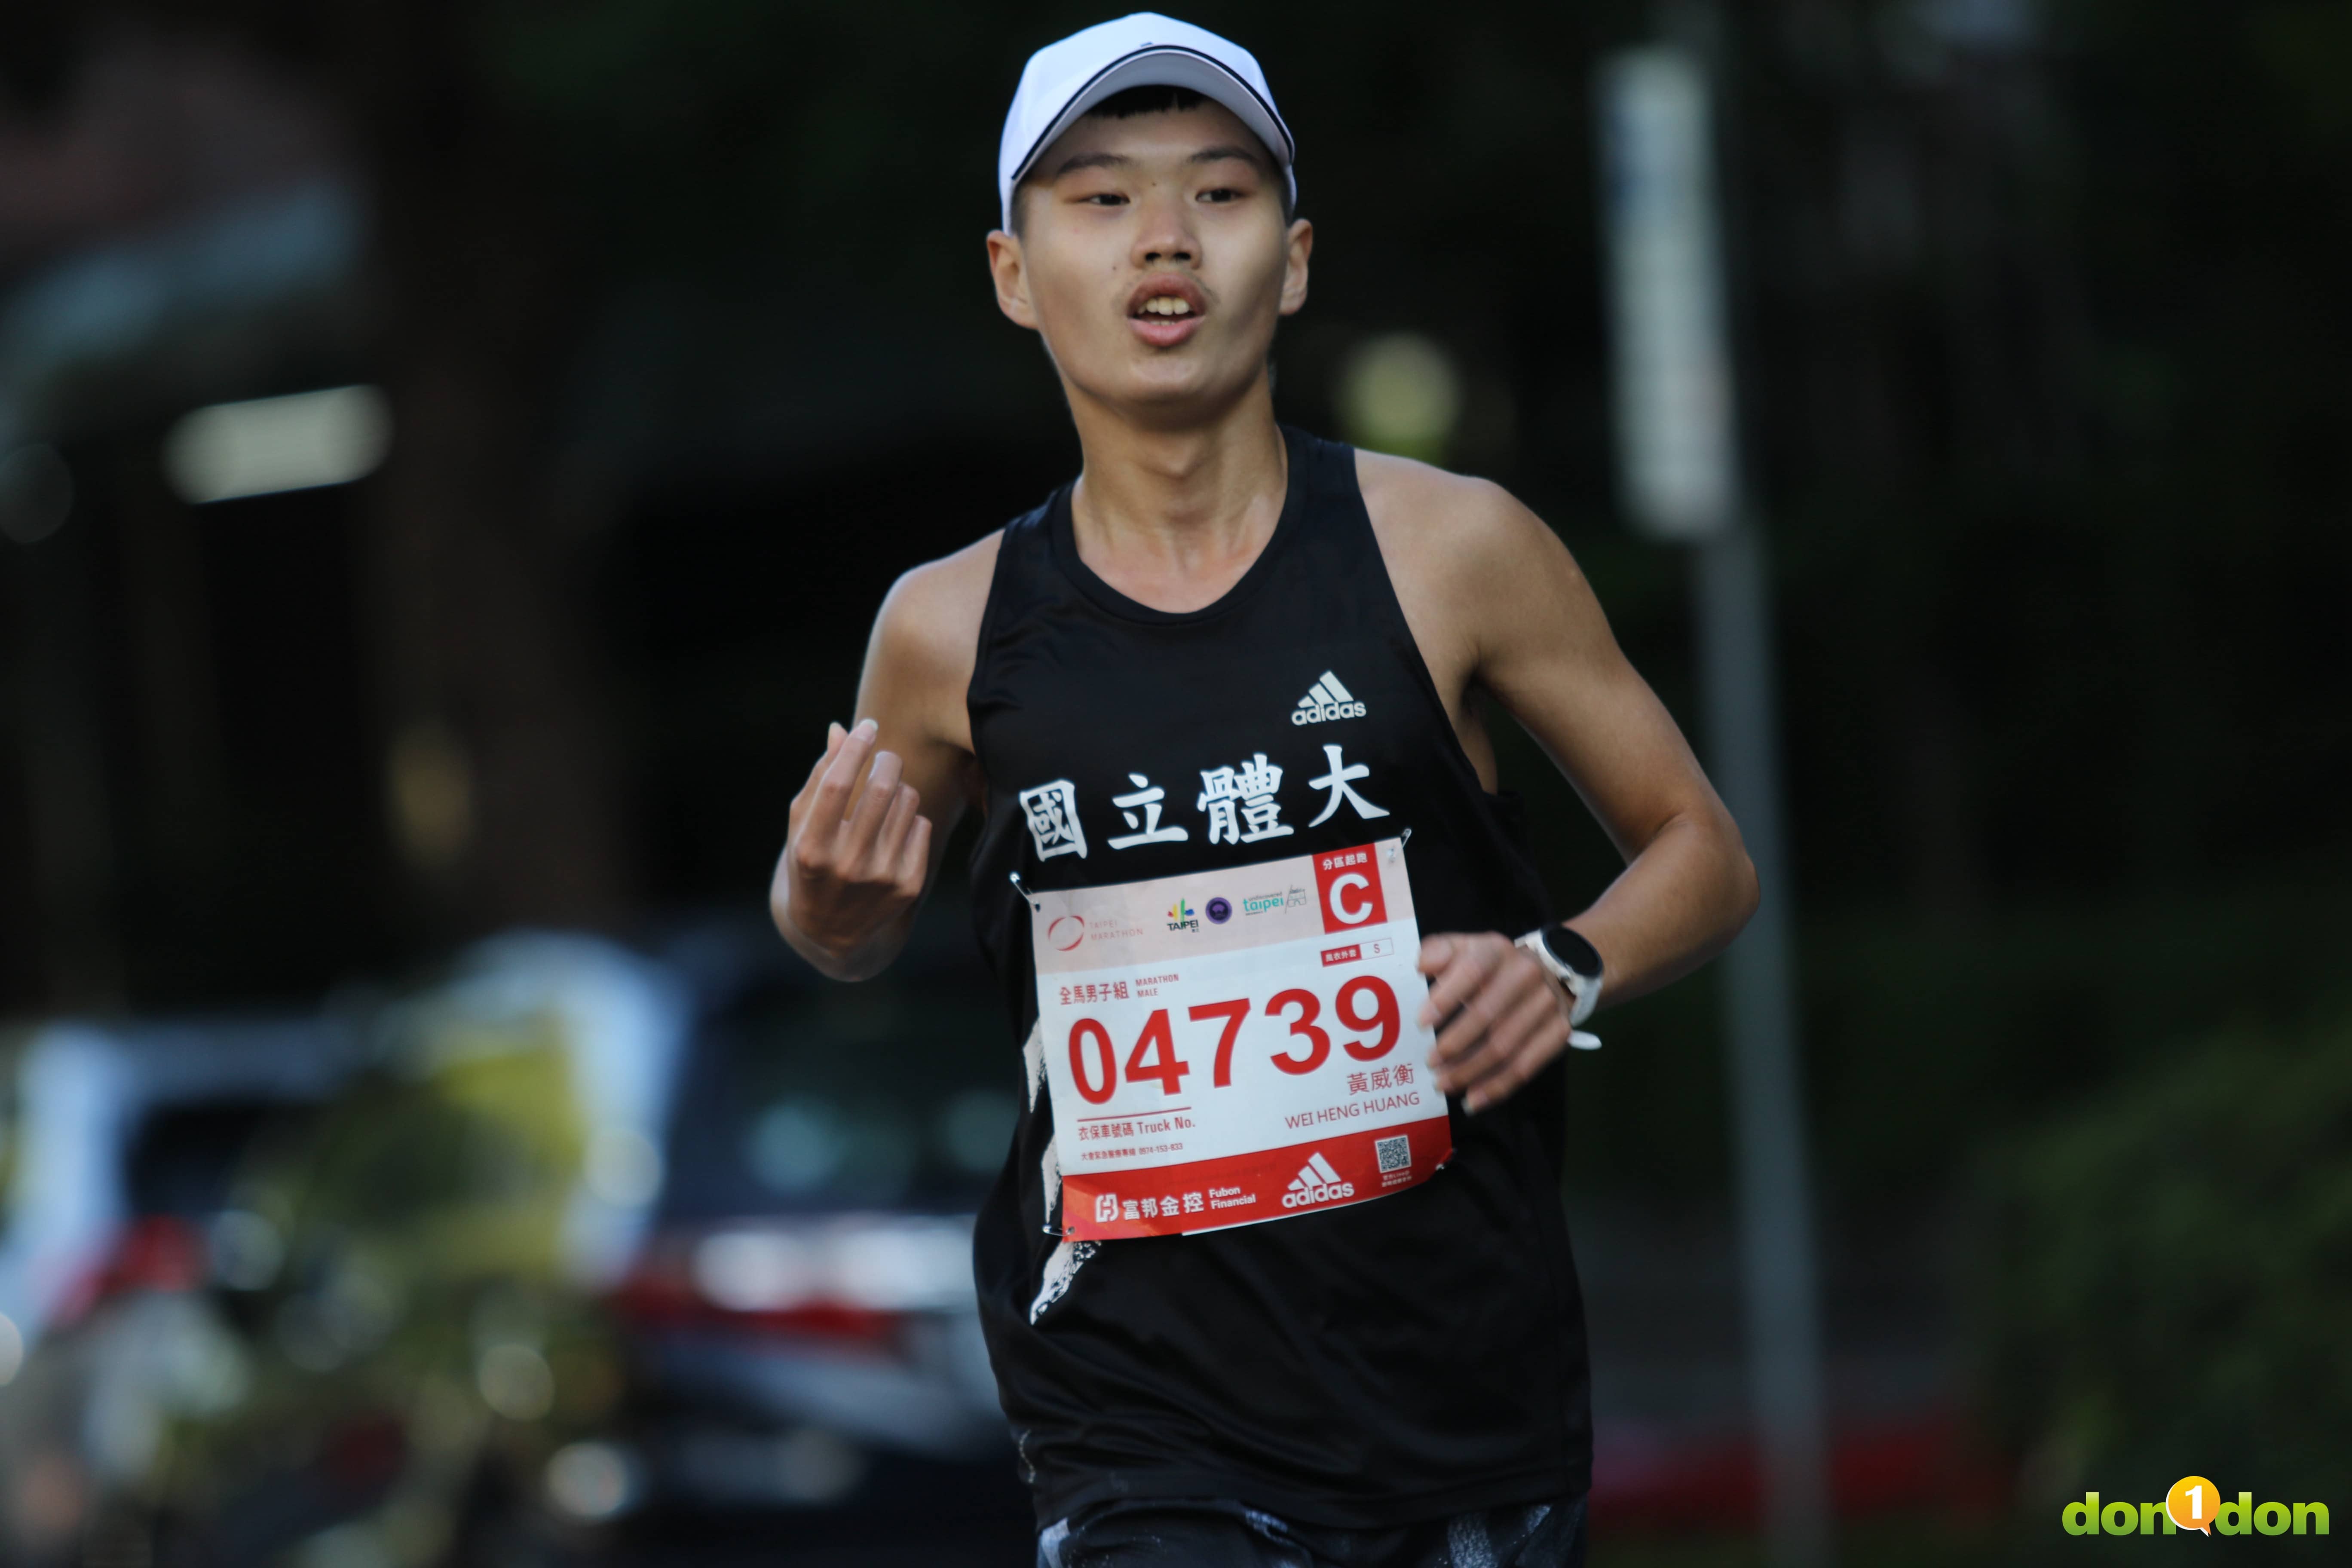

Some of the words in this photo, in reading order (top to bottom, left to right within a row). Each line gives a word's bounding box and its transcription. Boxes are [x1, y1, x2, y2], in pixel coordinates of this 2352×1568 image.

[1292, 700, 1366, 726] adidas
[1020, 744, 1390, 861] 國立體大
[1323, 852, 1368, 870] 分區起跑
[1243, 897, 1284, 913] taipei
[1330, 873, 1373, 924] C
[1090, 920, 1118, 929] TAIPEI
[1091, 928, 1143, 940] MARATHON
[1167, 919, 1199, 931] TAIPEI
[1373, 943, 1381, 954] S
[1135, 974, 1179, 987] MARATHON
[1060, 981, 1130, 1005] 全馬男子組
[1137, 988, 1158, 998] MALE
[1068, 975, 1400, 1105] 04739
[1346, 1063, 1415, 1096] 黃威衡
[1285, 1112, 1314, 1129] WEI
[1317, 1103, 1360, 1124] HENG
[1363, 1092, 1420, 1114] HUANG
[1078, 1122, 1134, 1141] 衣保車號碼
[1136, 1119, 1171, 1134] Truck
[1175, 1117, 1195, 1130] No.
[1209, 1187, 1241, 1198] Fubon
[1211, 1194, 1256, 1209] Financial
[1282, 1182, 1354, 1208] adidas
[1122, 1192, 1204, 1220] 富邦金控
